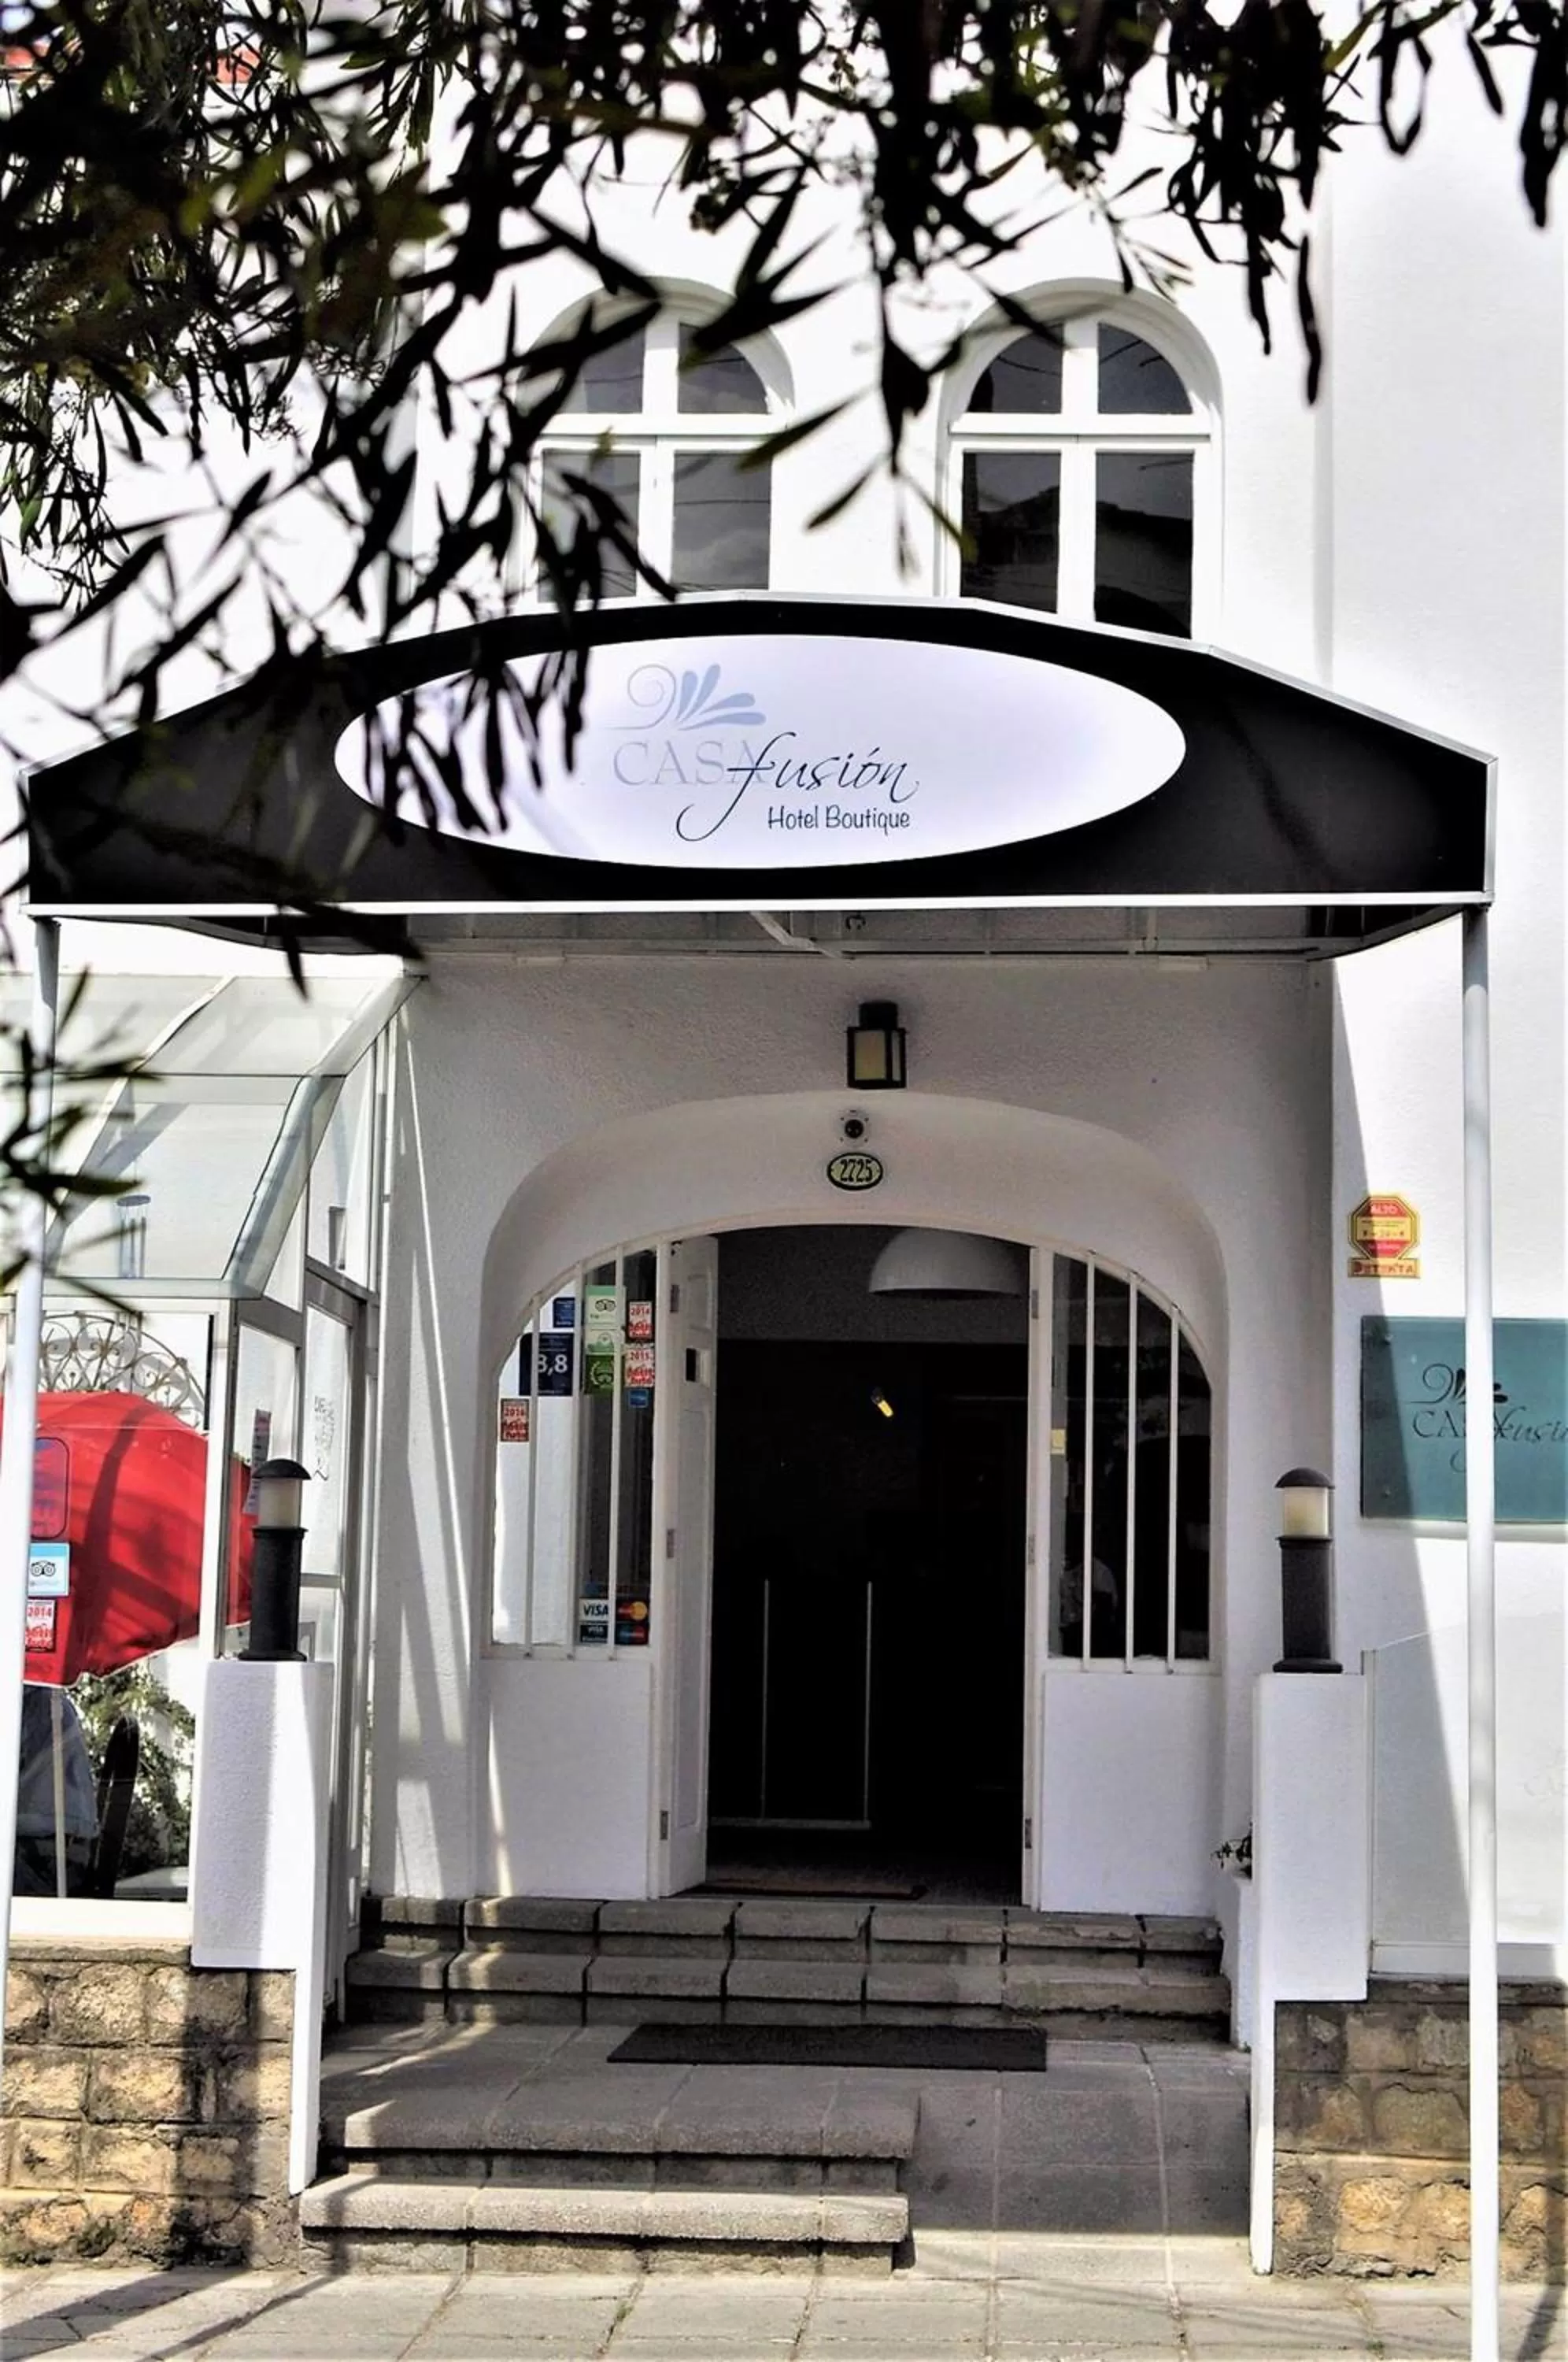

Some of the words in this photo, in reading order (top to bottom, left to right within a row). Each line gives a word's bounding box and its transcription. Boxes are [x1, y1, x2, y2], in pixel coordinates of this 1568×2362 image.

[613, 741, 771, 786] CASA
[676, 731, 919, 842] fusión
[768, 805, 819, 830] Hotel
[826, 805, 910, 836] Boutique
[840, 1158, 873, 1182] 2725
[583, 1603, 608, 1616] VISA
